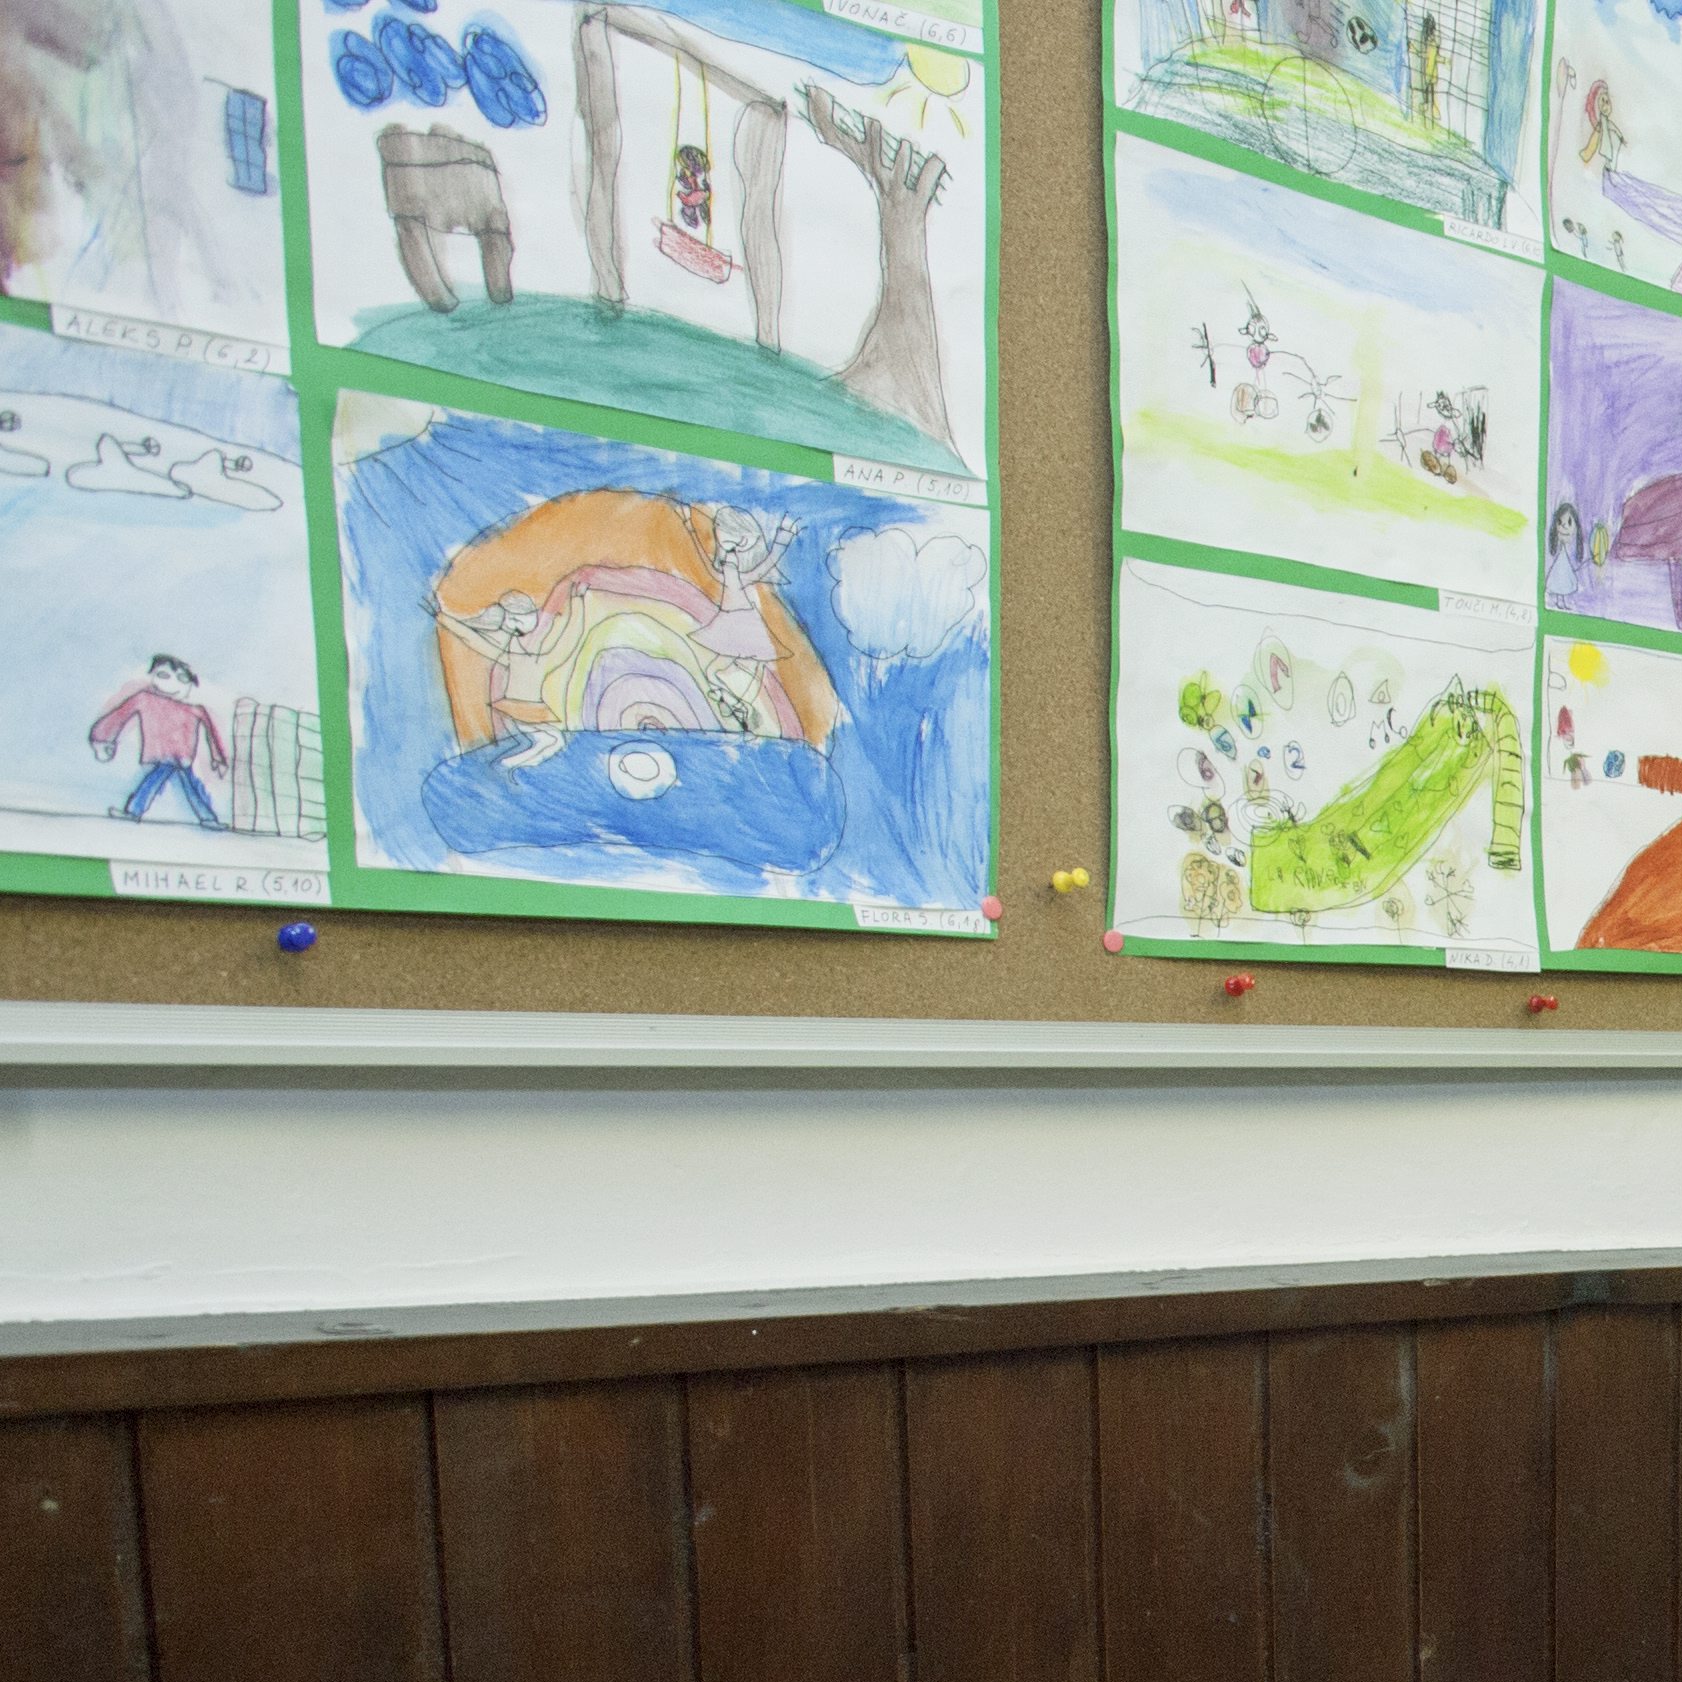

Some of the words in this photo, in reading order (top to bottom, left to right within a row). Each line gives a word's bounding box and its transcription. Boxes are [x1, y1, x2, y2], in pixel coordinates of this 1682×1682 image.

[919, 19, 967, 45] (6,6)
[66, 314, 161, 349] ALEKS
[203, 337, 271, 373] (6,2)
[843, 464, 883, 482] ANA
[124, 871, 222, 892] MIHAEL
[861, 910, 911, 926] FLORA
